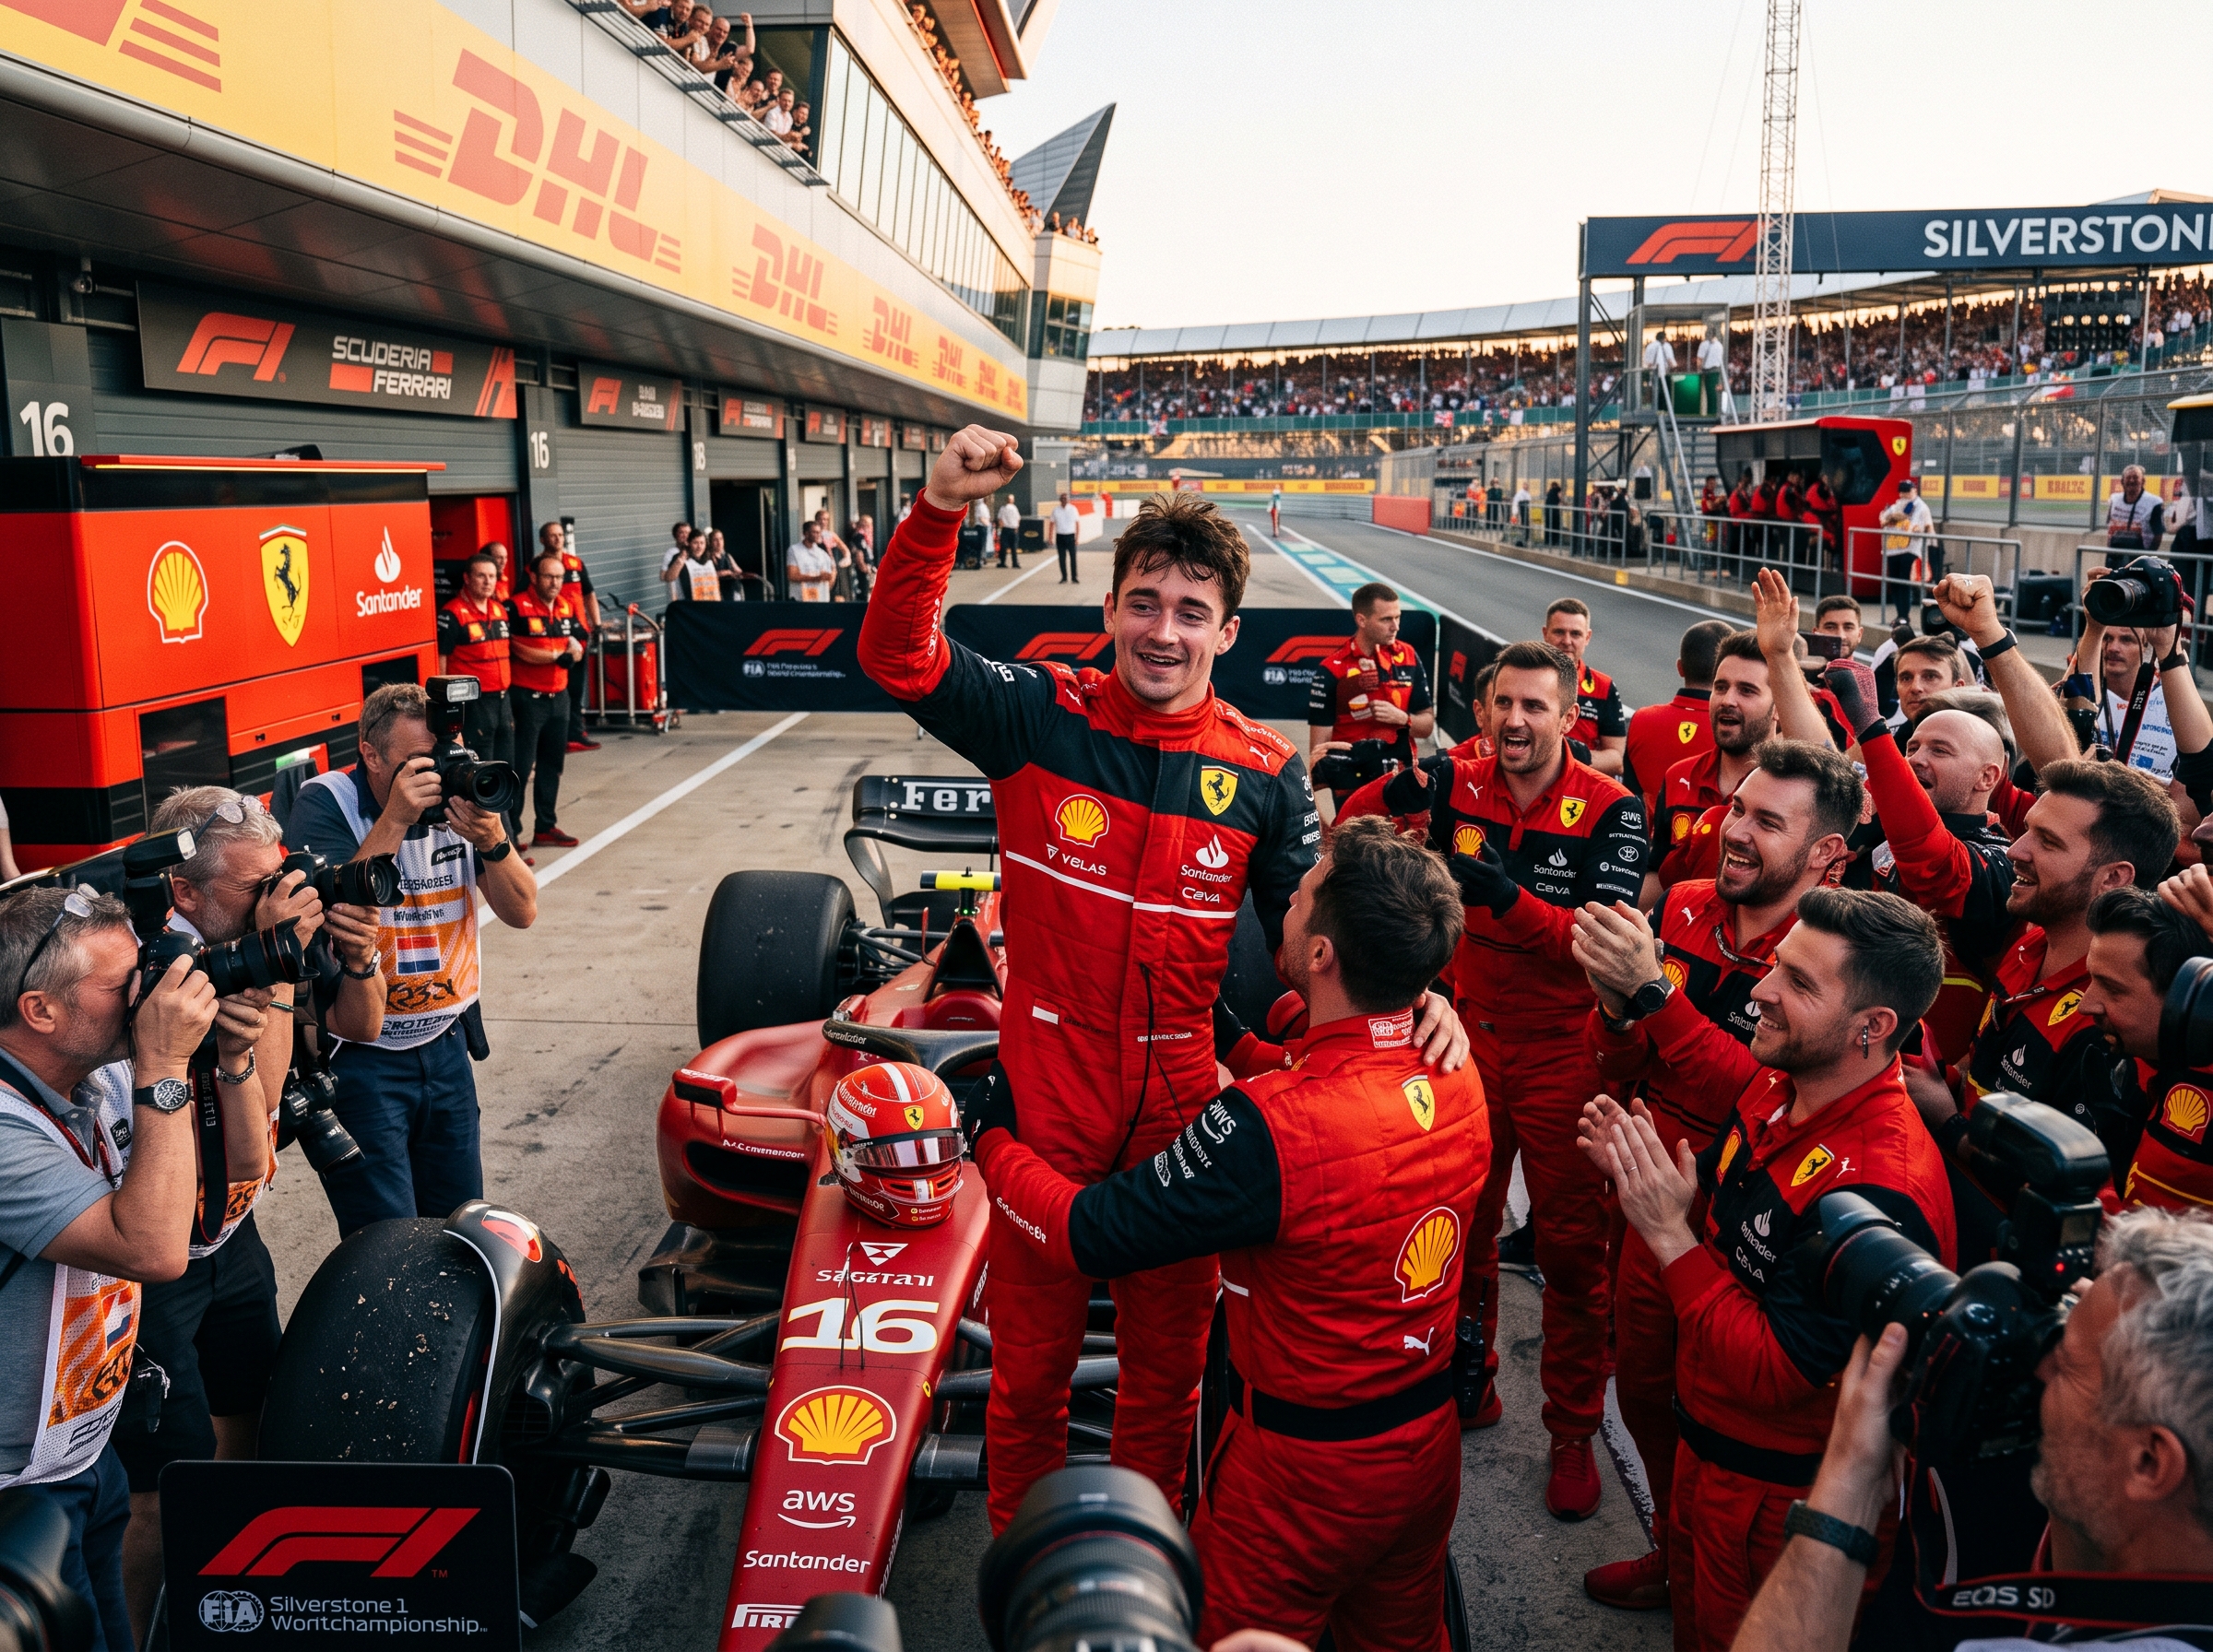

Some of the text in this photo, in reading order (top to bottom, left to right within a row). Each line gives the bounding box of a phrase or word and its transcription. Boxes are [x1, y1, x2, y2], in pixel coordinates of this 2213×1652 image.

[446, 48, 658, 262] DHL
[1626, 220, 1774, 264] F1
[748, 223, 828, 332] DHL
[176, 312, 295, 383] F1
[871, 295, 913, 366] DHL
[332, 335, 432, 372] SCUDERIA
[373, 369, 452, 400] FERRARI
[19, 401, 74, 457] 16
[530, 431, 550, 469] 16
[356, 584, 423, 618] Santander
[743, 629, 845, 656] F1
[1014, 632, 1115, 660] F1
[1265, 635, 1352, 663] F
[901, 781, 992, 812] Fer
[1180, 864, 1232, 883] Santander
[780, 1297, 940, 1354] 16
[782, 1489, 856, 1513] aws
[196, 1505, 482, 1578] F1
[432, 1569, 449, 1579] TM
[743, 1550, 871, 1574] Santander
[269, 1596, 409, 1614] Silverstone 1
